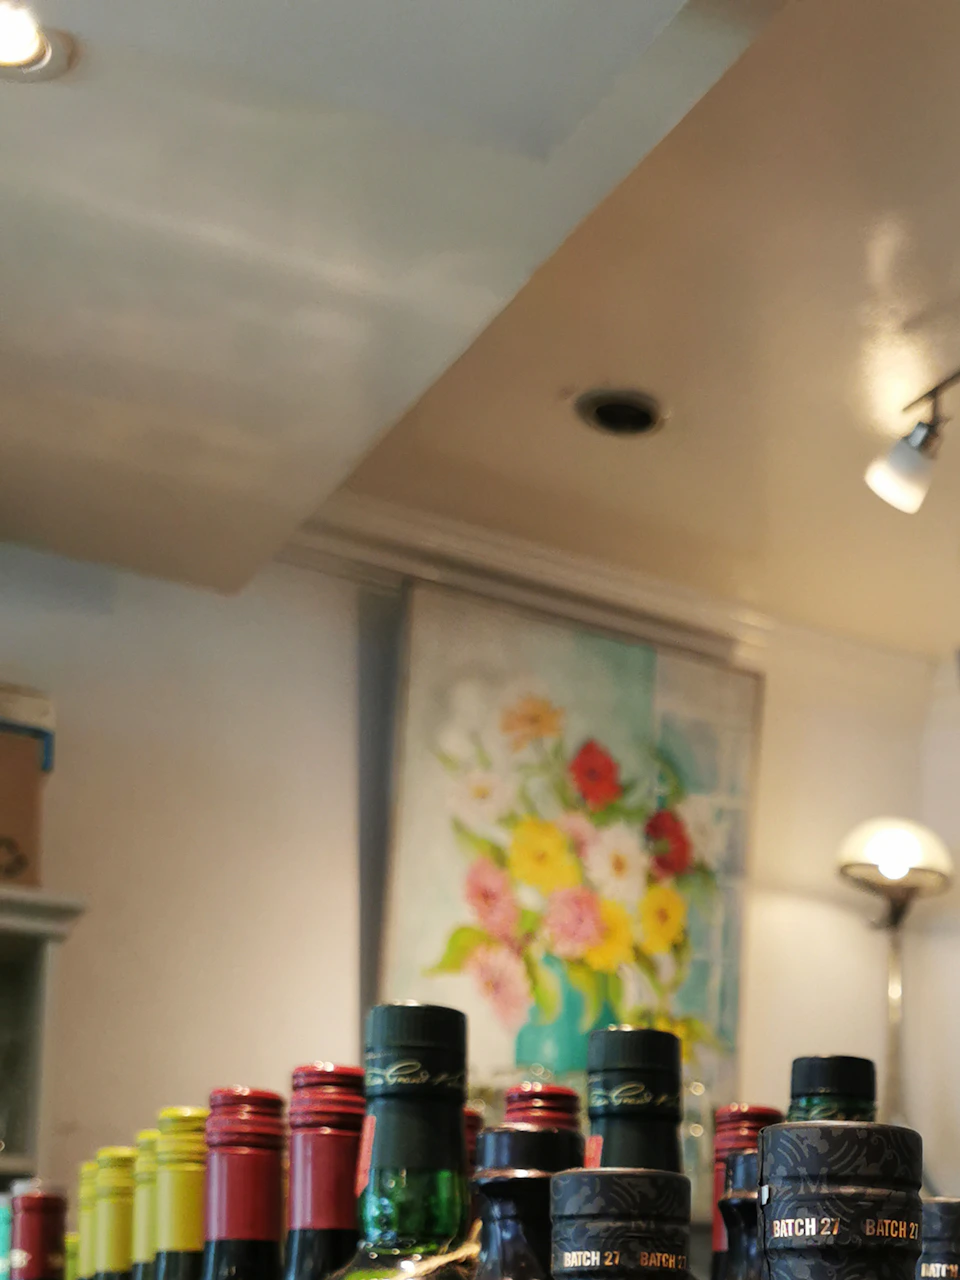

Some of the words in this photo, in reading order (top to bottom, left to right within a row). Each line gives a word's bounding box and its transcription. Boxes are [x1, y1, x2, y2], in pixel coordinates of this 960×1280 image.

[772, 1218, 816, 1238] BATCH
[820, 1217, 840, 1236] 27
[865, 1218, 907, 1239] BATCH
[909, 1222, 919, 1240] 27
[564, 1251, 600, 1267] BATCH
[604, 1251, 620, 1267] 27
[639, 1251, 675, 1269] BATCH
